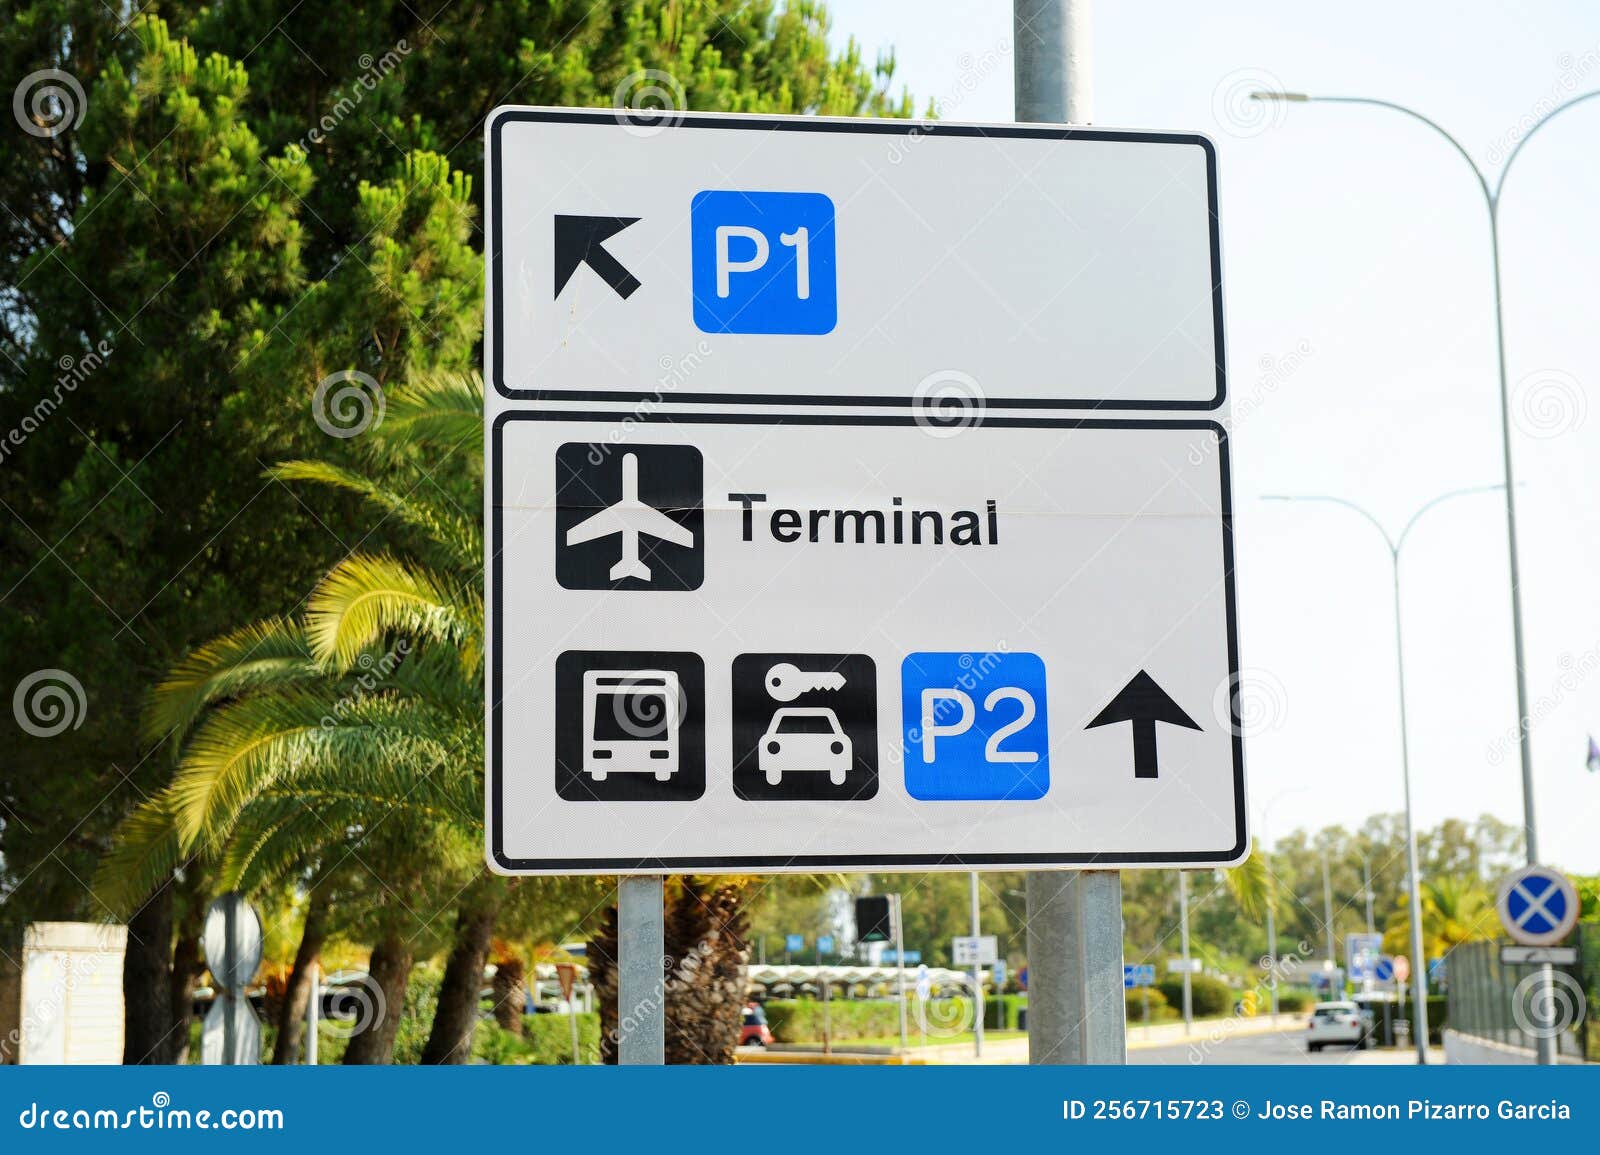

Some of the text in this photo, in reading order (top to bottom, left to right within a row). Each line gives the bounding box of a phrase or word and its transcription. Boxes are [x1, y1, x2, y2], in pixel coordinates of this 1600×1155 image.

[716, 226, 810, 300] P1
[728, 493, 999, 546] Terminal
[921, 686, 1039, 764] P2
